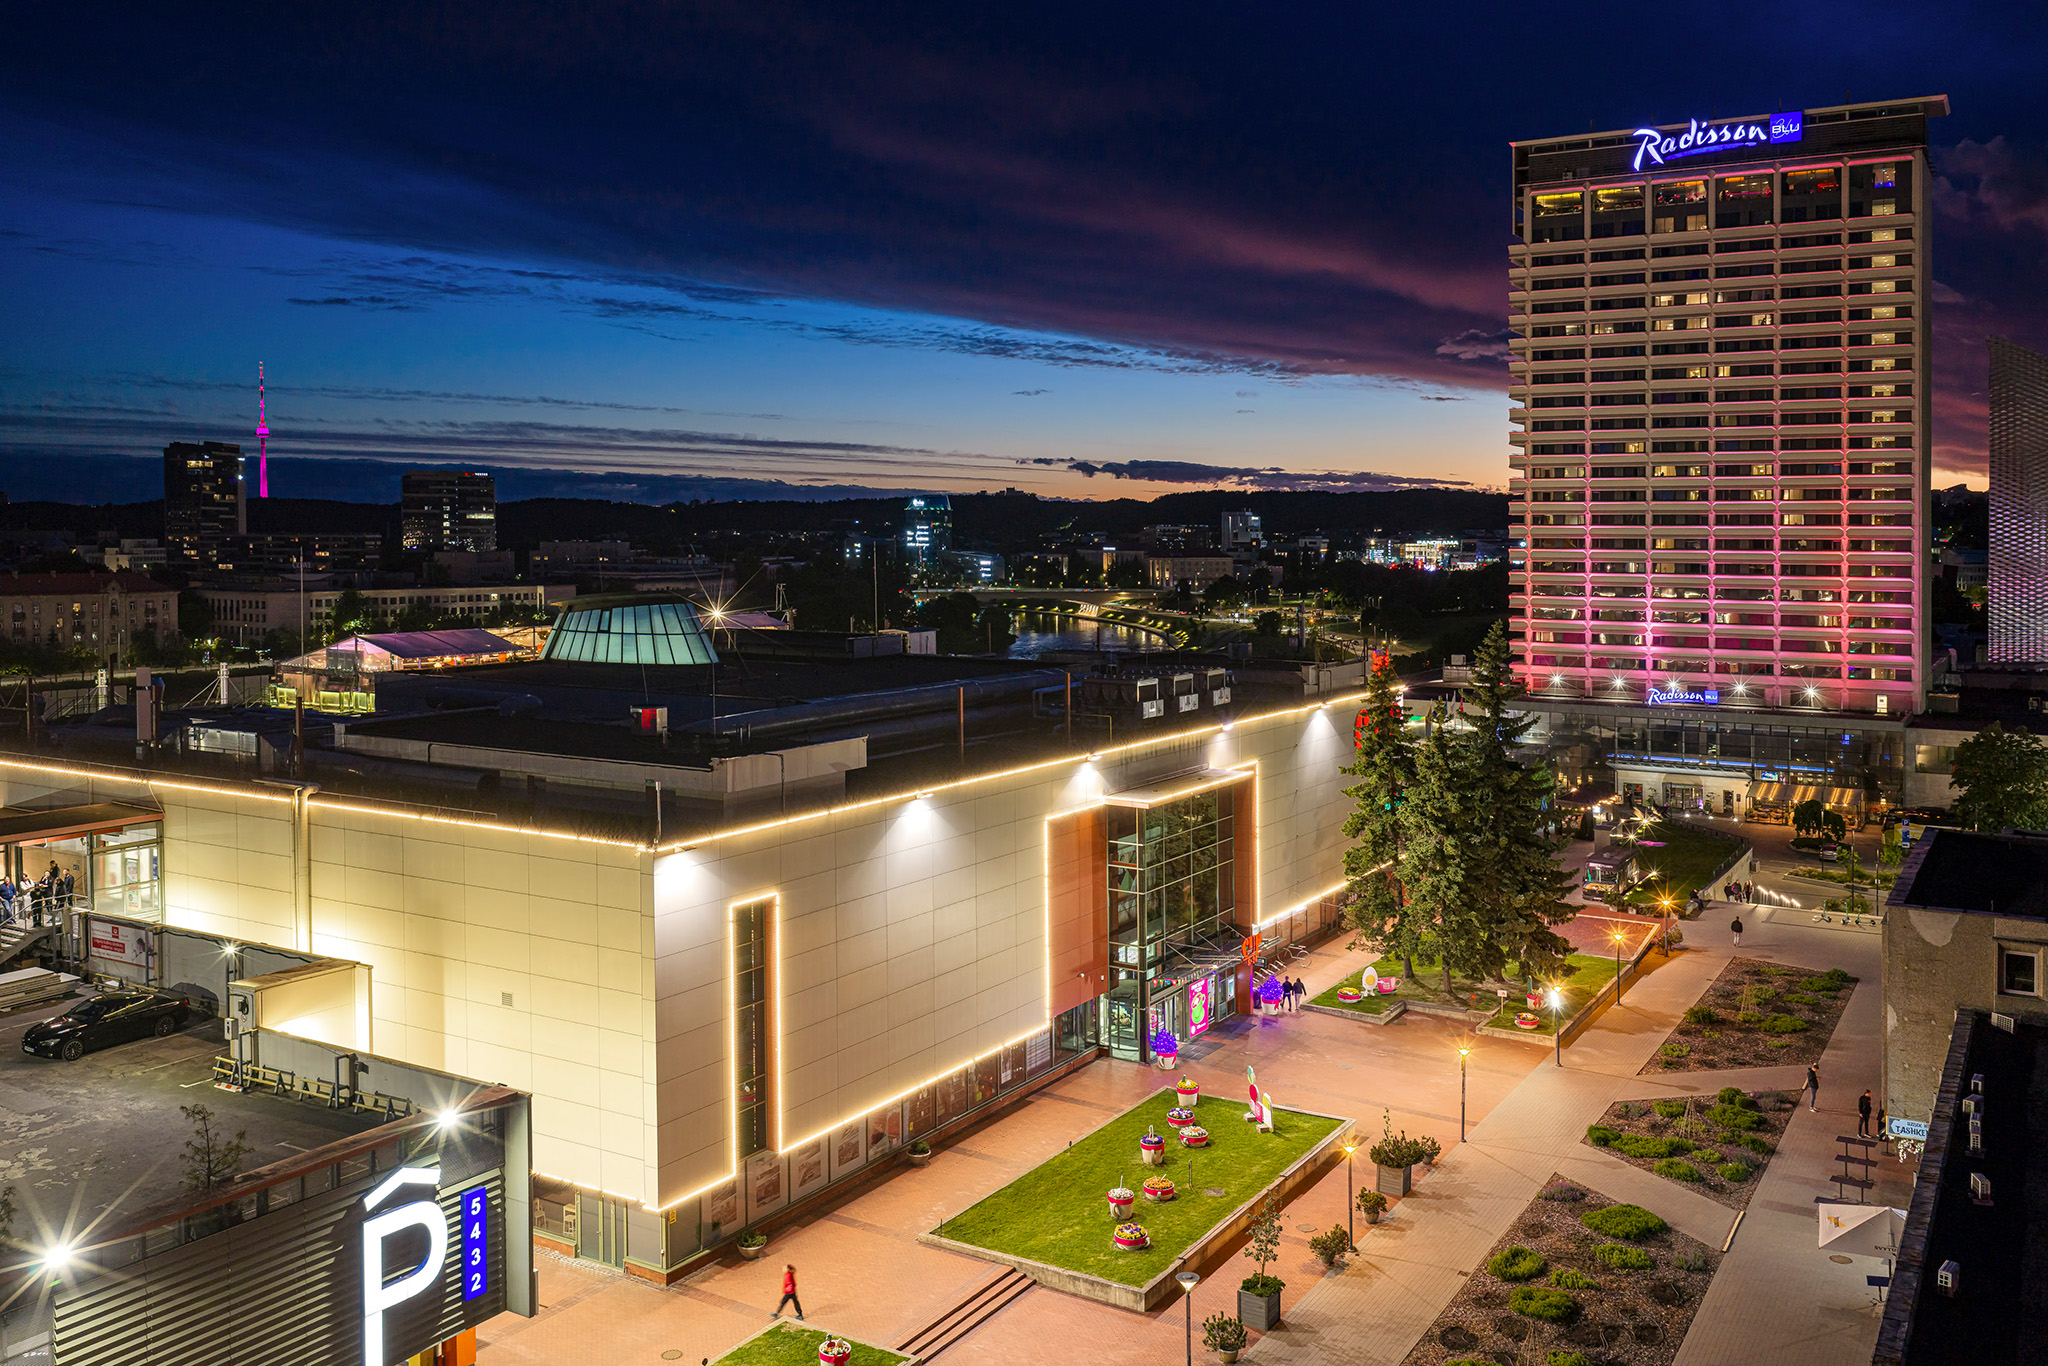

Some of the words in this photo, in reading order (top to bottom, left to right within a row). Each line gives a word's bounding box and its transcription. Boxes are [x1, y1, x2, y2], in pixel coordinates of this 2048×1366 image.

[1632, 117, 1768, 171] Radisson
[1647, 687, 1704, 706] Radisson
[471, 1197, 481, 1216] 5
[470, 1221, 481, 1239] 4
[471, 1247, 481, 1265] 3
[363, 1200, 448, 1366] P
[471, 1272, 481, 1292] 2
